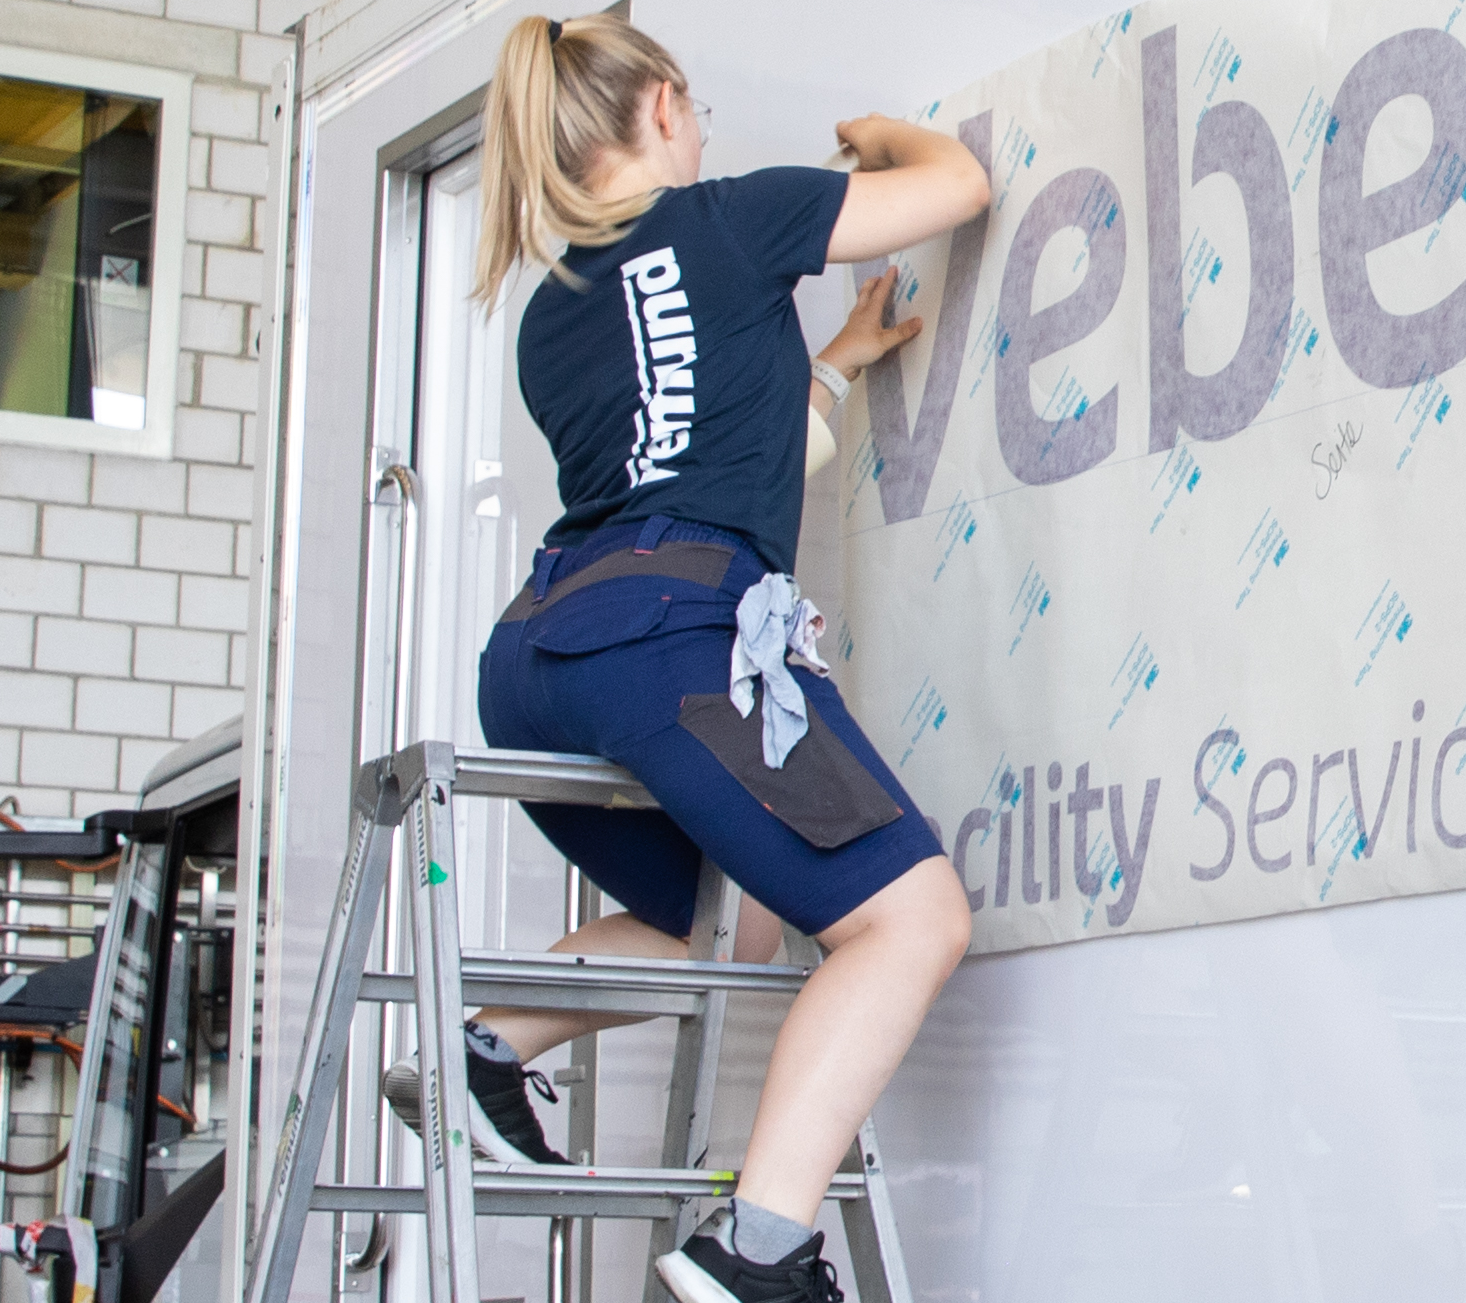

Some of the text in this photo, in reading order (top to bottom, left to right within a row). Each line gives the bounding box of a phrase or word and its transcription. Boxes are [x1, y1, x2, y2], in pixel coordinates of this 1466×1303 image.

[620, 246, 697, 490] remund
[416, 800, 429, 889] emund
[925, 760, 1162, 928] cility
[429, 1068, 443, 1171] remund
